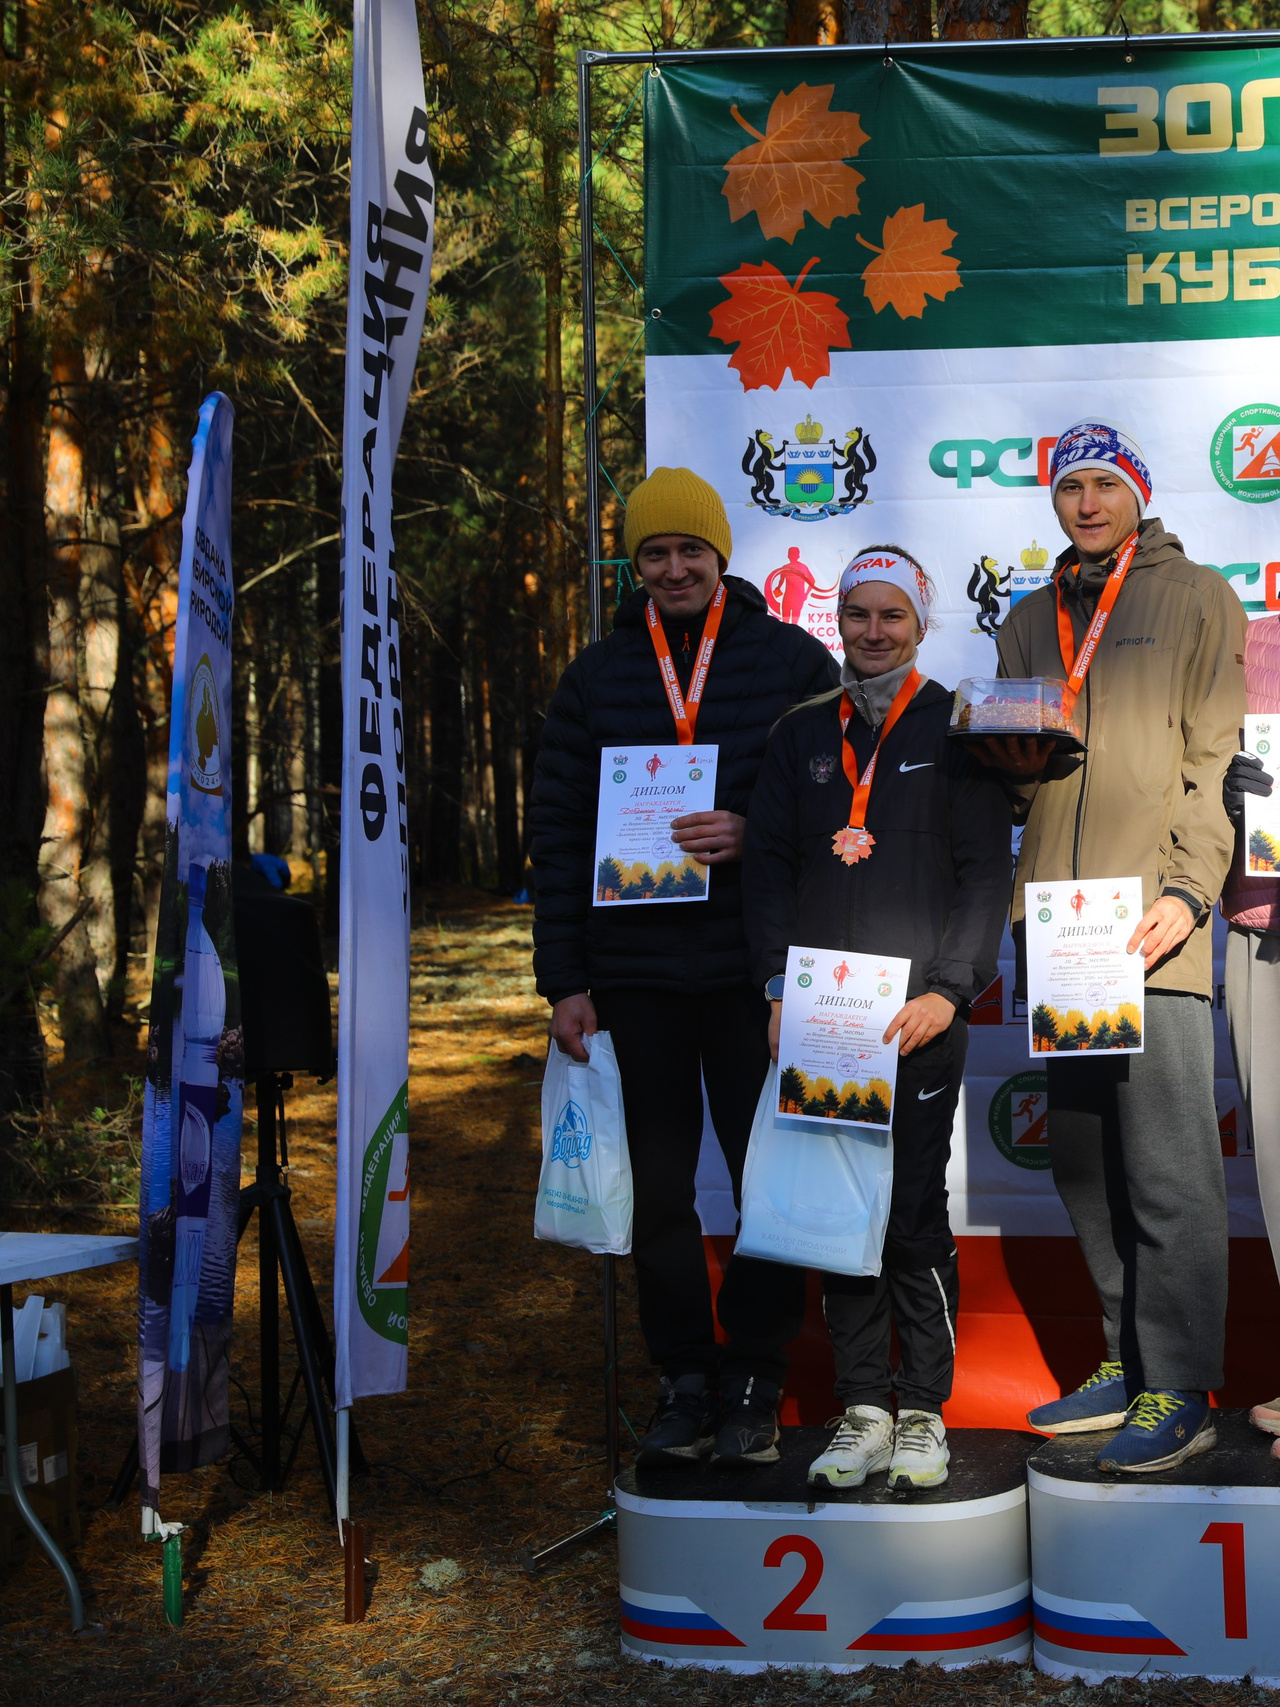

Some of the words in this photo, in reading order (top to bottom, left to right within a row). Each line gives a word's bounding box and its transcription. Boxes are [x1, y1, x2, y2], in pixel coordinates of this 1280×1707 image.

[1214, 417, 1237, 456] ФЕДЕРАЦИЯ
[1215, 459, 1234, 489] ОБЛАСТИ
[359, 200, 386, 842] ФЕДЕРАЦИЯ
[194, 525, 227, 583] ОЗДАНА
[1113, 547, 1133, 579] ТЮМЕНЬ
[1077, 640, 1096, 679] ЗОЛОТАЯ
[1093, 611, 1108, 638] ОСЕНЬ
[1115, 637, 1144, 648] PATRIOT
[664, 655, 676, 682] ОСЕНЬ
[693, 666, 707, 703] ЗОЛОТАЯ
[702, 638, 714, 665] ОСЕНЬ
[671, 683, 687, 719] ЗОЛОТАЯ
[630, 785, 686, 798] ДИПЛОМ
[856, 834, 868, 845] 2
[1057, 924, 1114, 939] ДИПЛОМ
[814, 994, 874, 1010] ДИПЛОМ
[819, 1011, 868, 1021] НАГРАЖДАЕТСЯ
[993, 1083, 1015, 1121] ФЕДЕРАЦИЯ
[993, 1125, 1013, 1154] ОБЛАСТИ
[361, 1110, 402, 1213] ФЕДЕРАЦИЯ
[761, 1232, 796, 1246] КАТАЛОГ
[797, 1239, 847, 1255] ПРОДУКЦИИ
[762, 1534, 829, 1633] 2
[1200, 1522, 1248, 1640] 1
